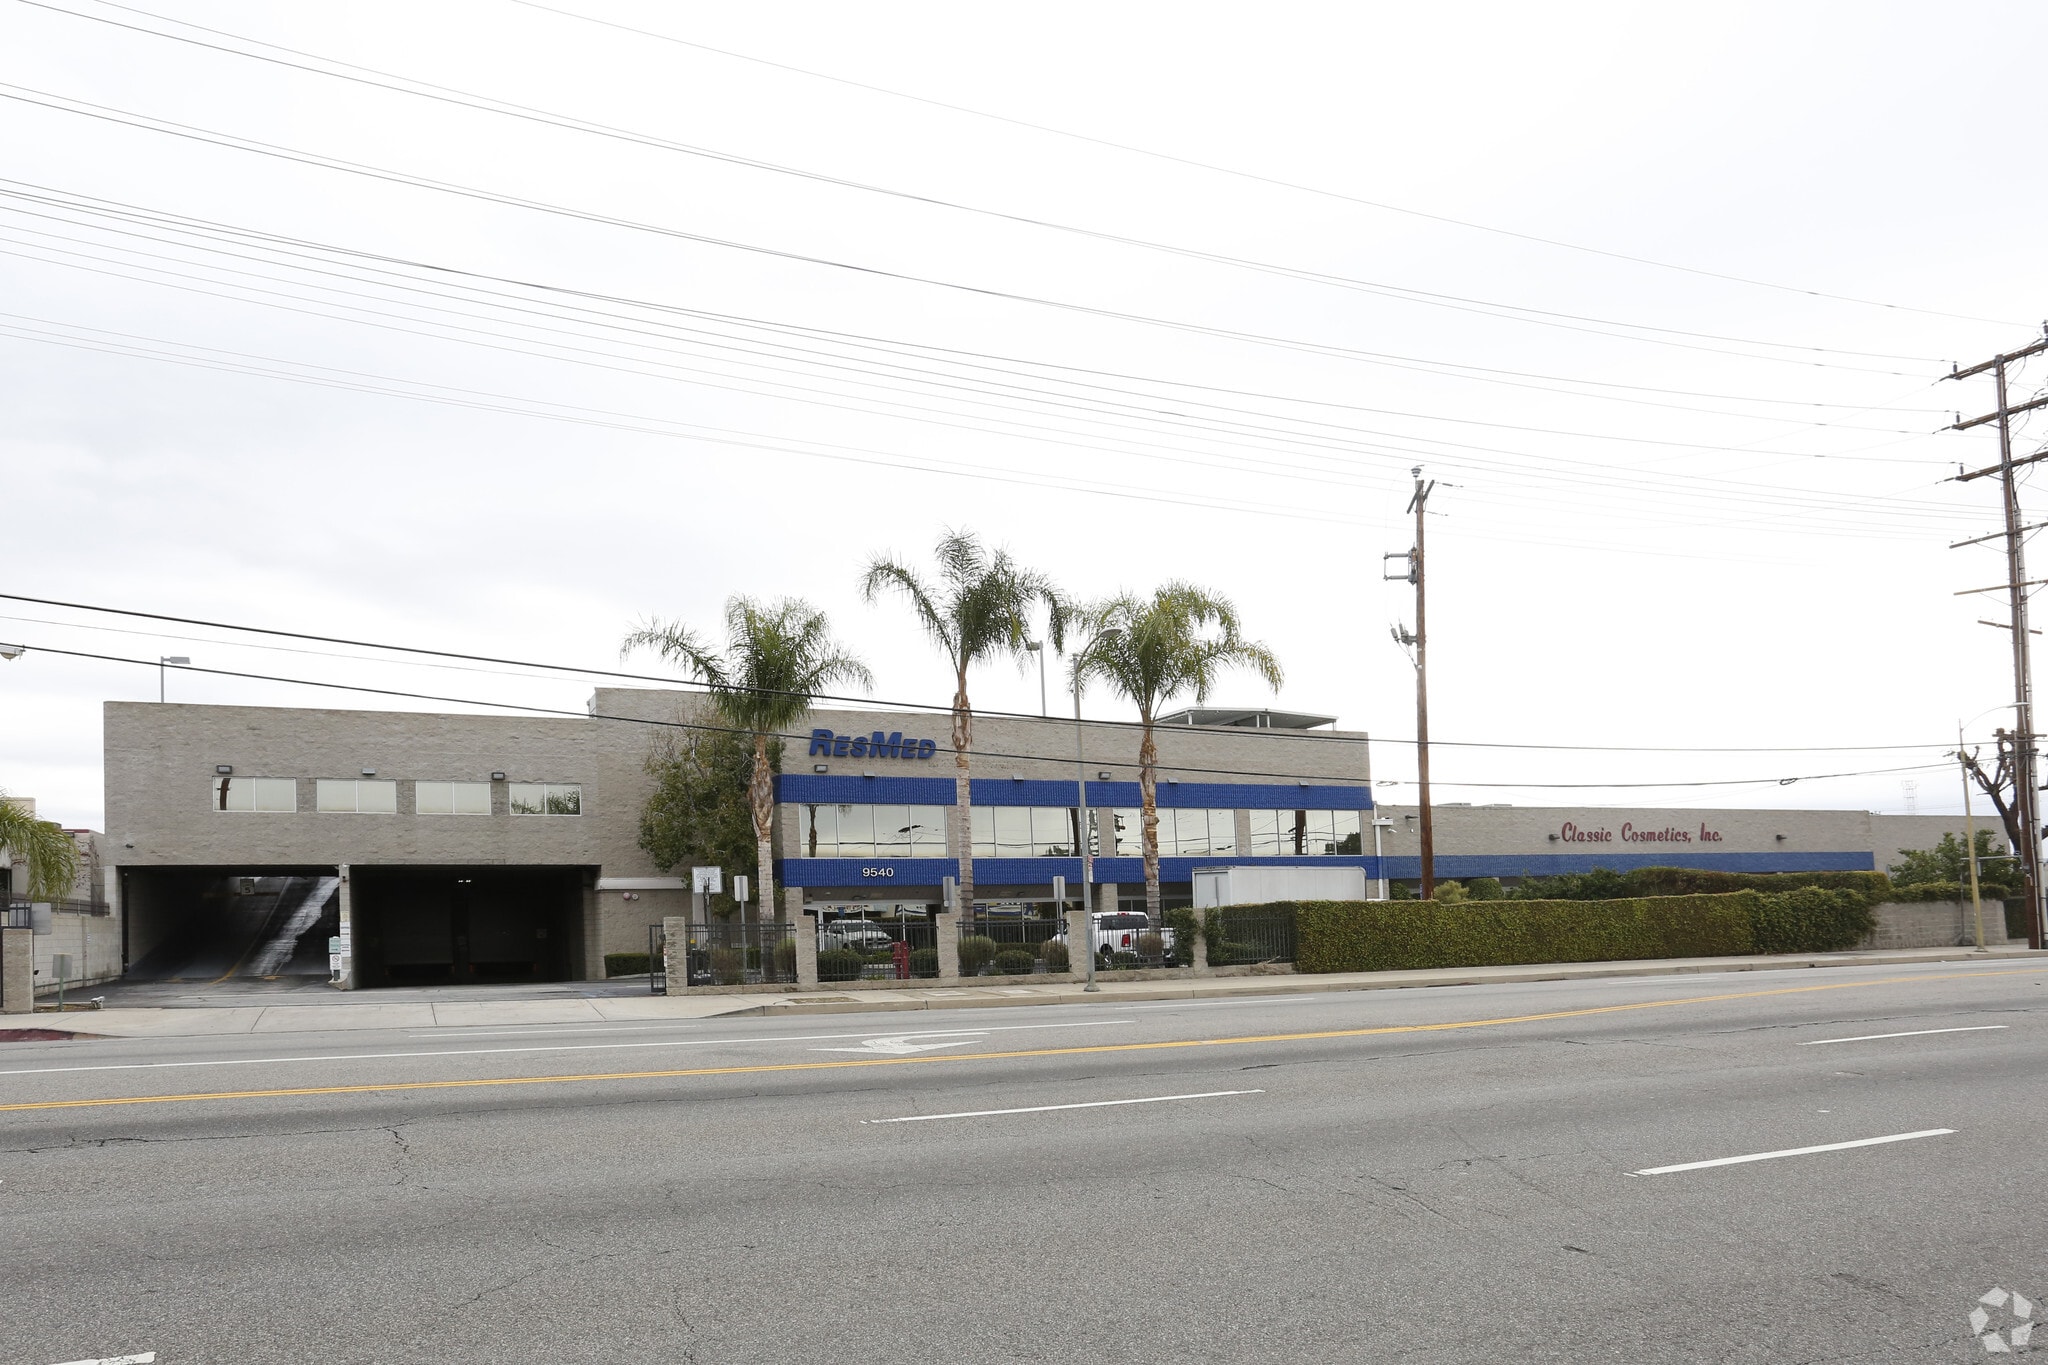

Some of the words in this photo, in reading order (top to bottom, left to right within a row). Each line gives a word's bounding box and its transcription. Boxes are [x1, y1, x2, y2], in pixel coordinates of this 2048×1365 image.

[1561, 822, 1612, 842] Classic
[1621, 822, 1691, 843] Cosmetics,
[1700, 822, 1723, 842] Inc.
[862, 867, 894, 877] 9540
